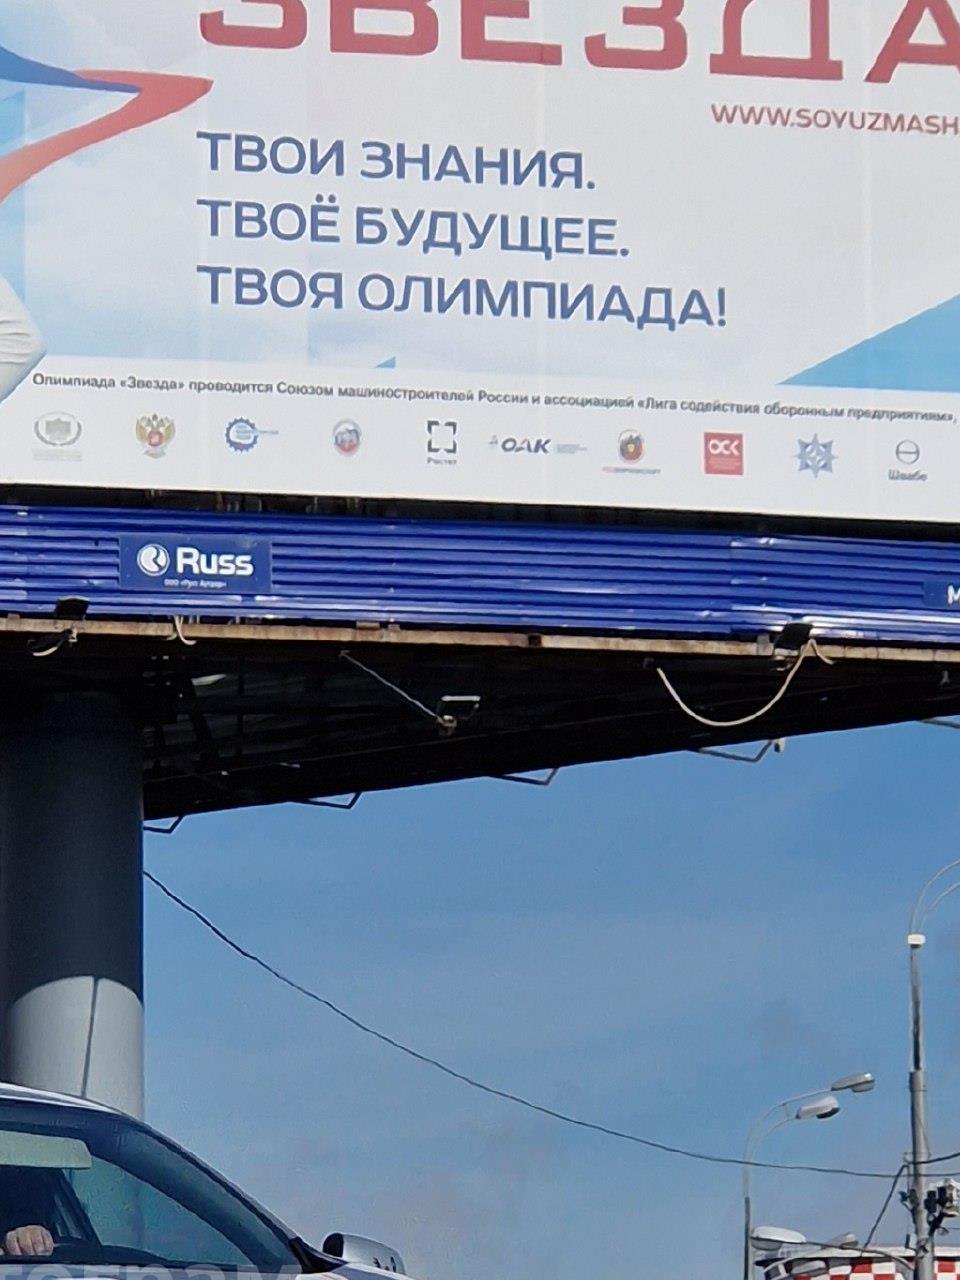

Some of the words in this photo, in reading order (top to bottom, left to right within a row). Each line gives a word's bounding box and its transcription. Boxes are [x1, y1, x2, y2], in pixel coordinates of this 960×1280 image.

[711, 103, 959, 136] WWW.SOYUZMASH
[196, 131, 345, 177] ТВОИ
[360, 141, 596, 190] ЗНАНИЯ.
[196, 194, 341, 243] ТВОЁ
[355, 206, 630, 260] БУДУЩЕЕ.
[196, 265, 343, 310] ТВОЯ
[358, 273, 727, 331] ОЛИМПИАДА!
[33, 373, 116, 389] Олимпиада
[120, 376, 184, 392] «Звезда»
[189, 380, 273, 394] проводится
[277, 381, 333, 396] Союзом
[338, 387, 474, 402] машиностроителей
[478, 390, 528, 404] России
[531, 395, 541, 405] и
[544, 395, 634, 409] ассоциацией
[637, 397, 677, 410] «Лига
[680, 400, 760, 413] содействия
[764, 402, 844, 417] оборонным
[176, 547, 254, 576] Russ
